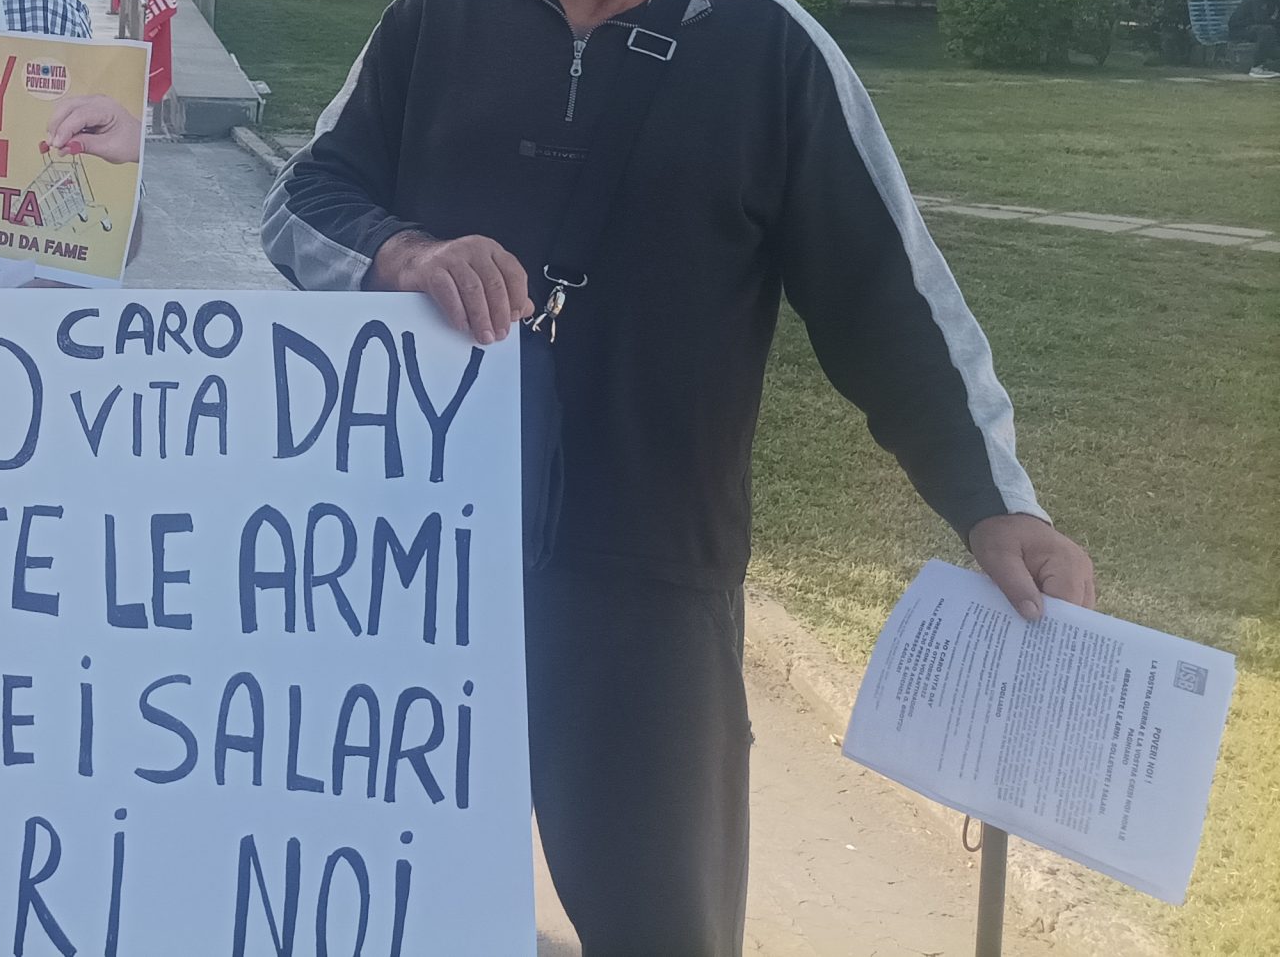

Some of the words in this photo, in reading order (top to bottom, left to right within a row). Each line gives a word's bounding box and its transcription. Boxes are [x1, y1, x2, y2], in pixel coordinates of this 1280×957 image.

[26, 76, 50, 89] POVERI
[19, 238, 40, 252] DA
[44, 239, 89, 261] FAME
[56, 299, 244, 360] CARO
[272, 320, 484, 483] DAY
[70, 374, 229, 459] VITA
[104, 512, 193, 631] LE
[942, 639, 951, 651] NO
[936, 652, 946, 673] CARO
[1151, 660, 1158, 670] LA
[931, 674, 940, 691] VITA
[1118, 668, 1132, 709] ABBASSATE
[1145, 671, 1156, 700] VOSTRA
[1177, 663, 1198, 691] USB
[995, 682, 1008, 719] VOGLIAMO
[1116, 711, 1124, 720] LE
[1139, 701, 1151, 730] GUERRA
[1149, 727, 1162, 760] POVERI
[1145, 762, 1156, 779] NOI
